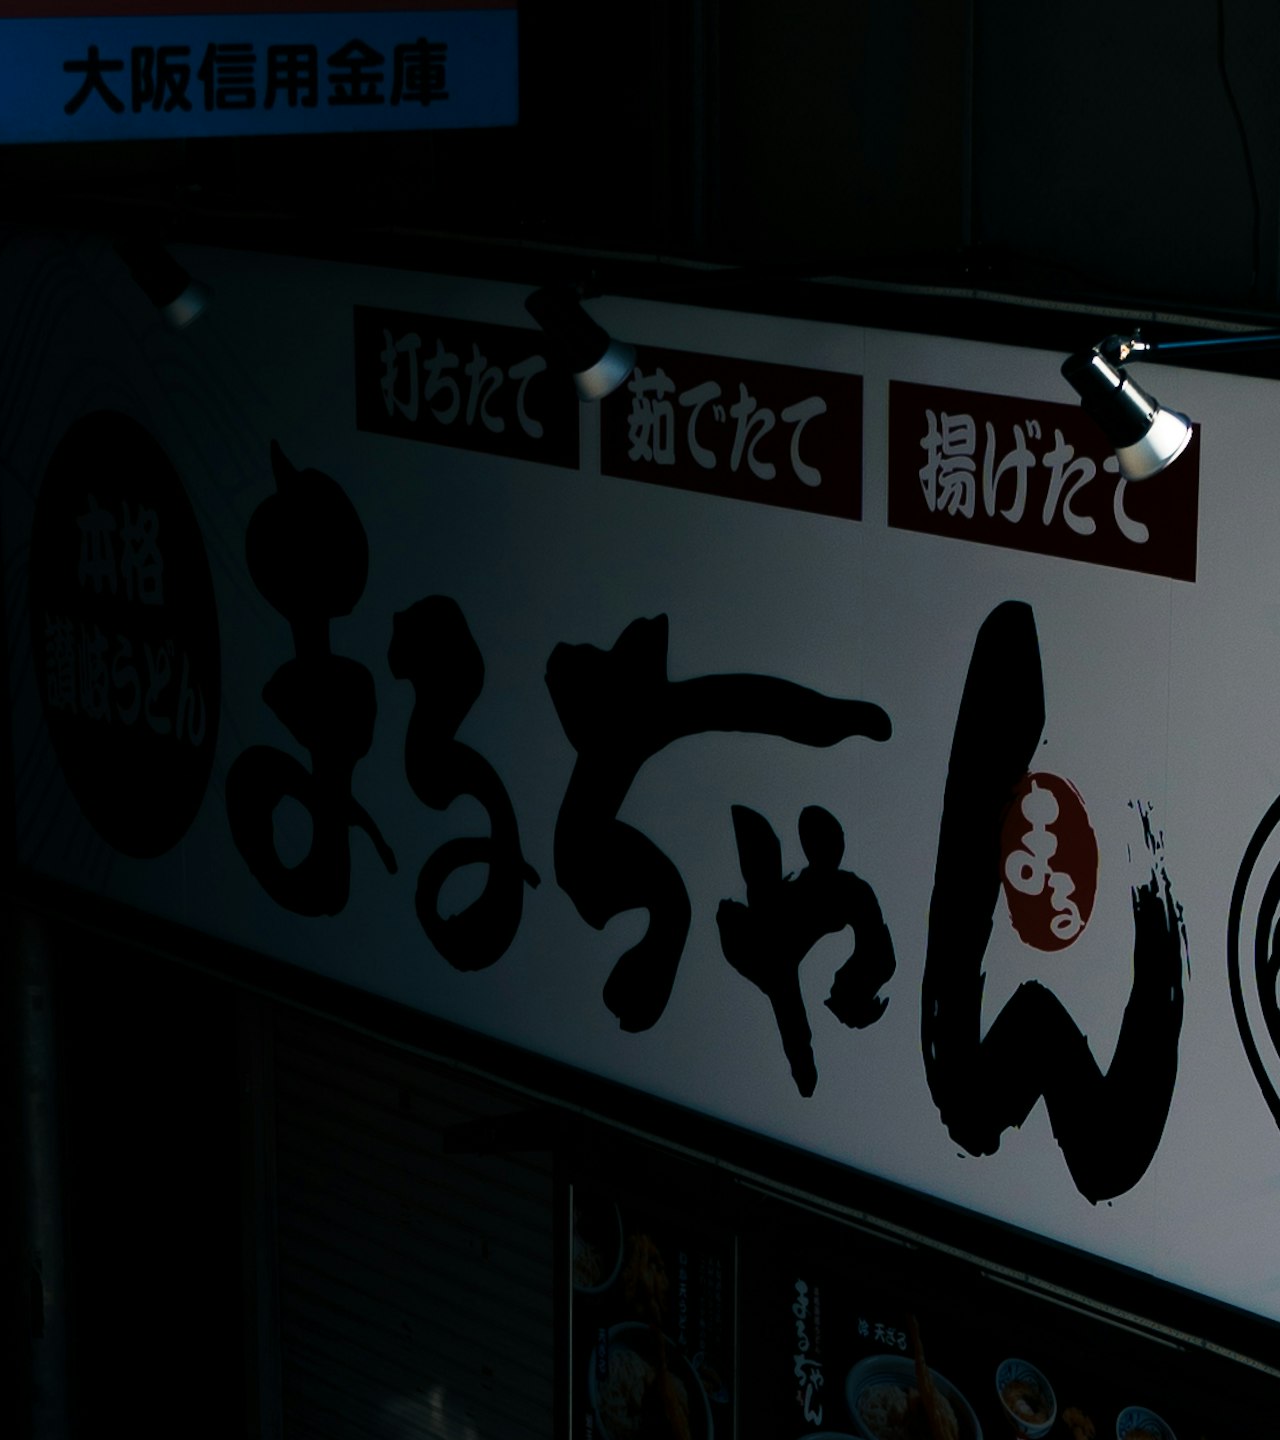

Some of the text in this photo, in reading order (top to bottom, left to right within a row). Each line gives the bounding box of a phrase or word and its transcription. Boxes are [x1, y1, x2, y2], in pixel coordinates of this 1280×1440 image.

[62, 38, 452, 116] 大阪信用金庫
[379, 326, 548, 439] 打ちたて
[625, 374, 826, 490] 茹でたて
[918, 409, 1151, 544] 揚げたて
[76, 491, 165, 606] 本格
[225, 438, 1190, 1206] まるちゃん
